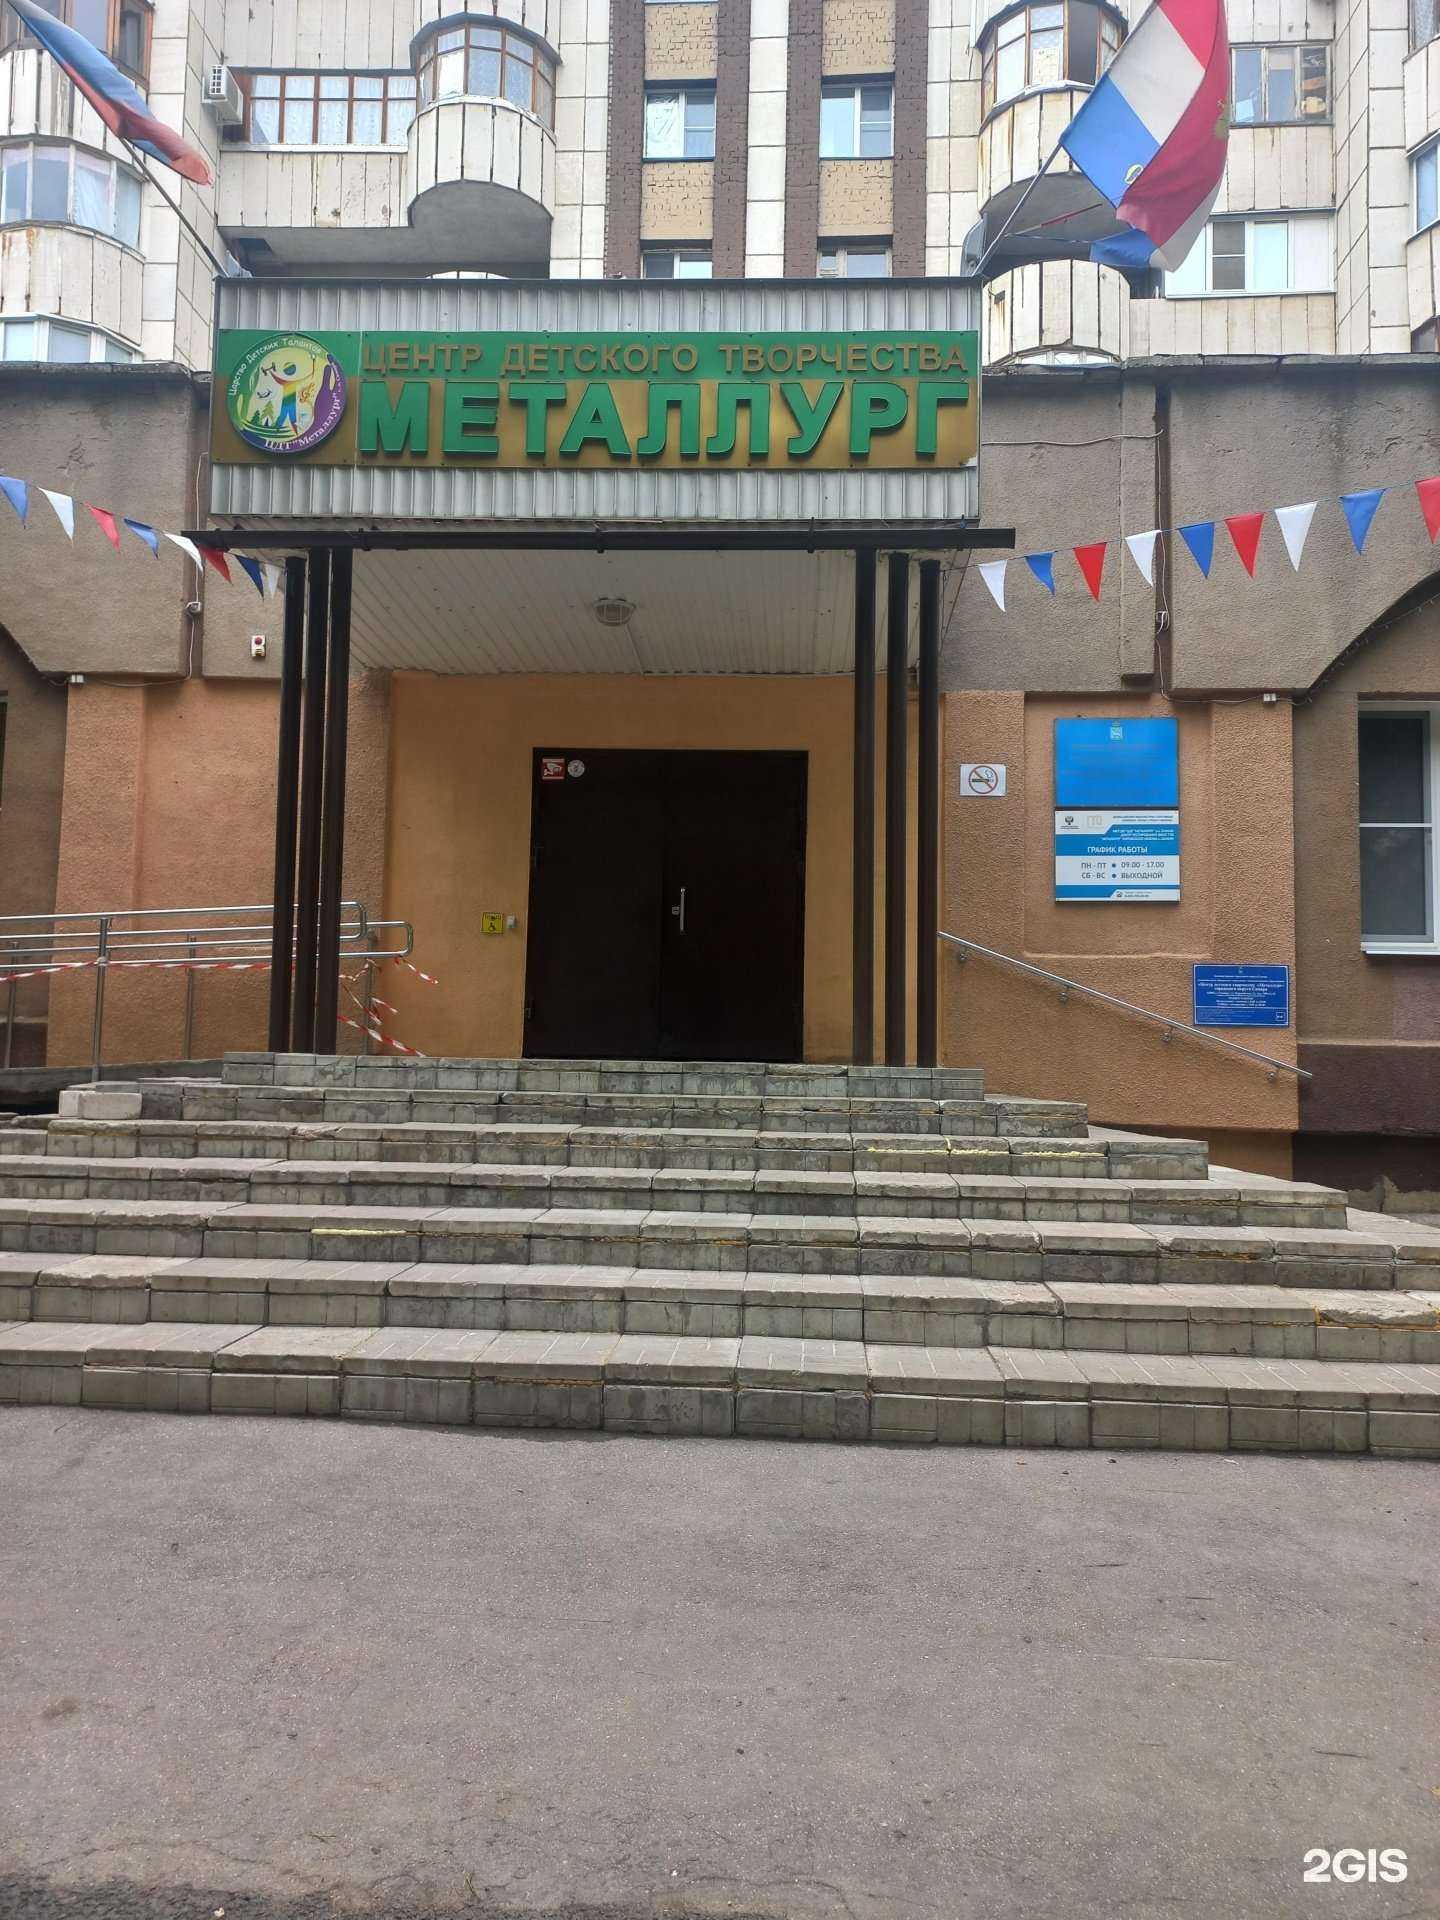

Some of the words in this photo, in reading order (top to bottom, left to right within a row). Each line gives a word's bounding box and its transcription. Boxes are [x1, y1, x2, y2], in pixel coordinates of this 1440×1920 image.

[246, 341, 279, 363] Детских
[363, 344, 482, 376] ЦЕНТР
[501, 344, 698, 377] ДЕТСКОГО
[719, 344, 968, 373] ТВОРЧЕСТВА
[360, 380, 969, 456] МЕТАЛЛУРГ
